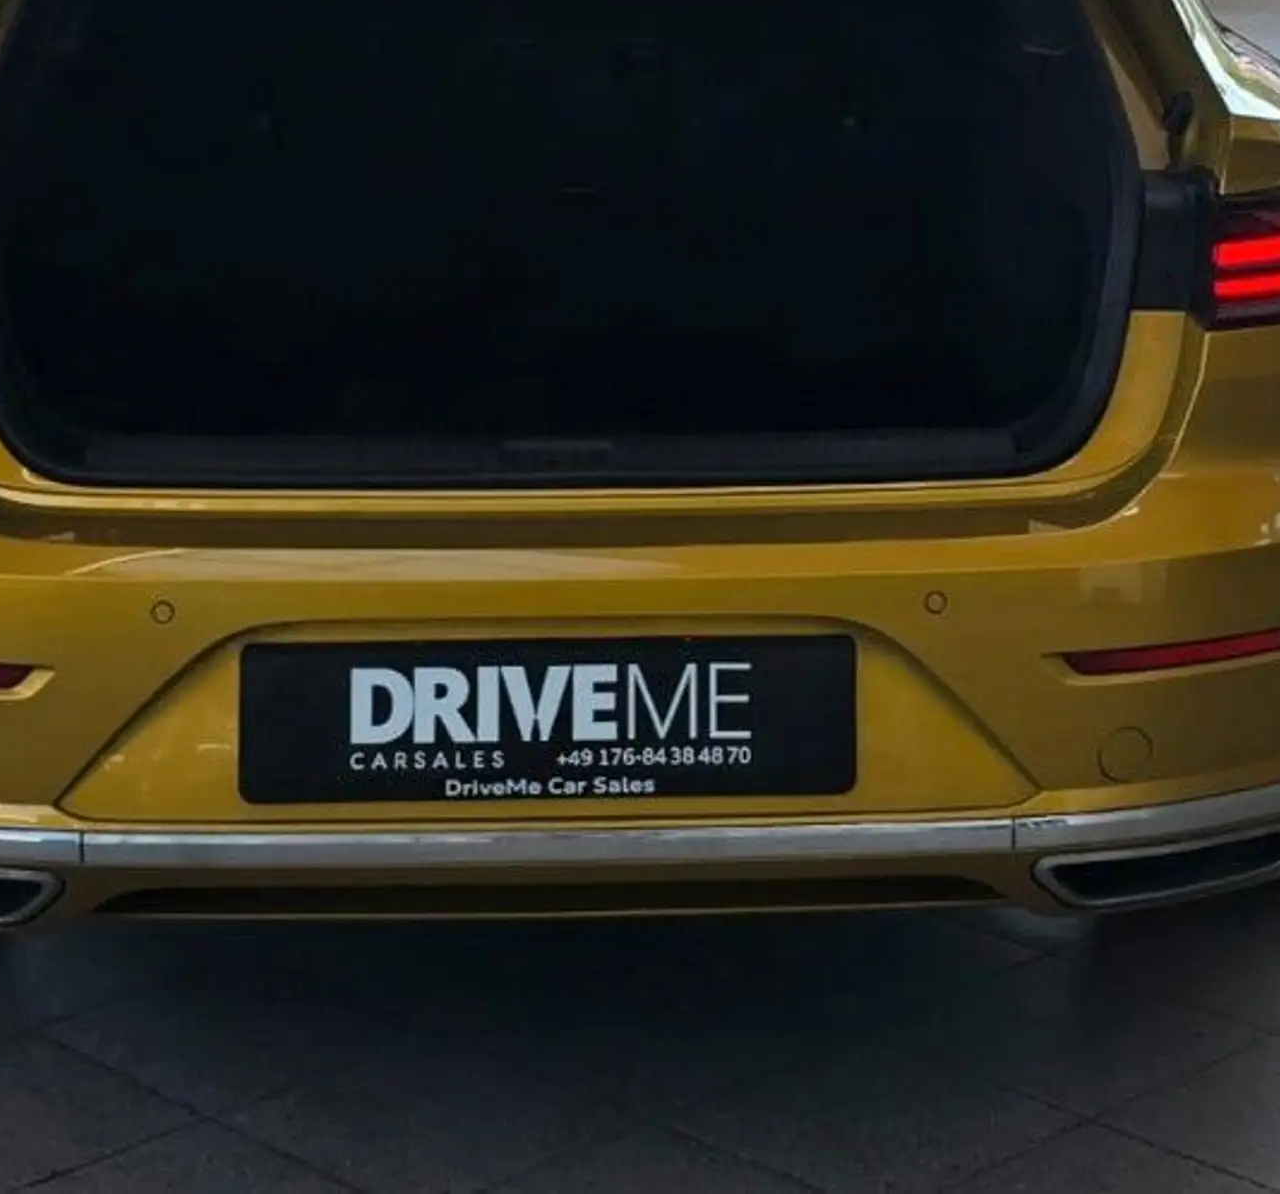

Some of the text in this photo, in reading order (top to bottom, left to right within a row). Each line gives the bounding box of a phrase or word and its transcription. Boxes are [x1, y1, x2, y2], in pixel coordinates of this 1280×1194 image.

[350, 663, 752, 744] DRIVEME
[350, 750, 505, 770] CARSALES
[558, 748, 593, 766] +49
[445, 776, 656, 797] DriveMe Car Sales
